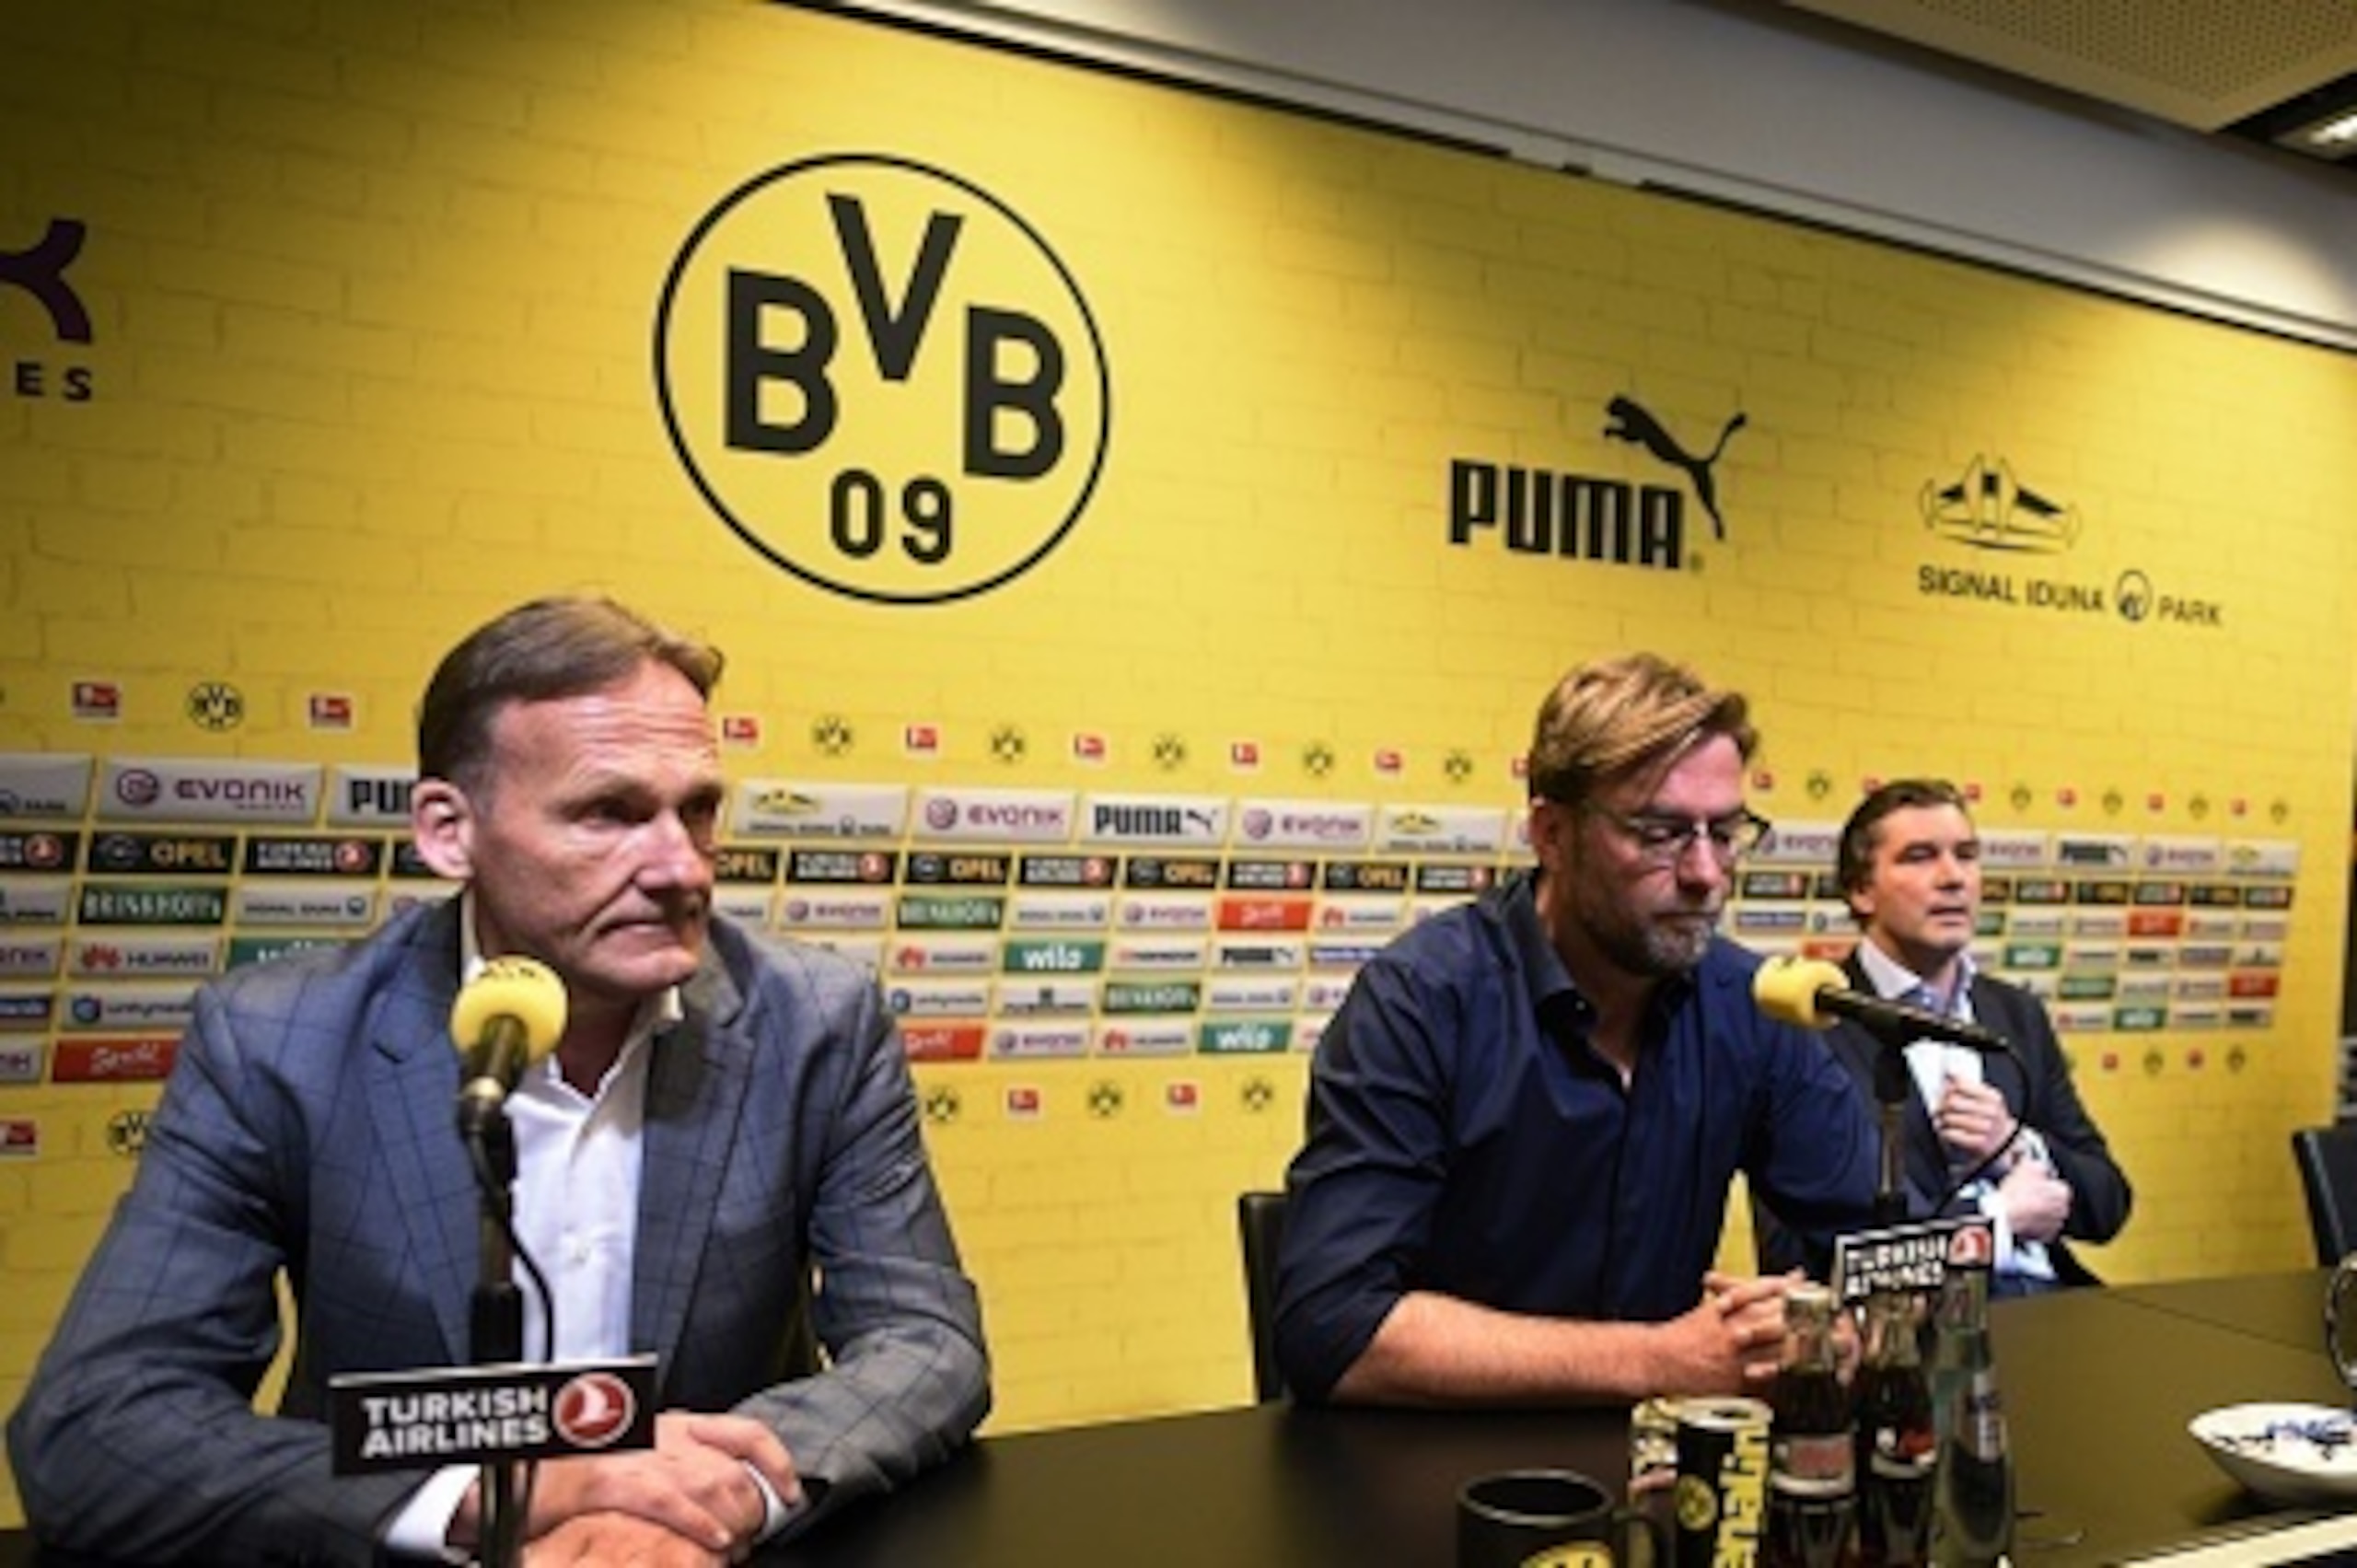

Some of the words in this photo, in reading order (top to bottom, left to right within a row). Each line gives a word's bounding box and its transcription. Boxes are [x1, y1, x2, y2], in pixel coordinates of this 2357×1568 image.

[724, 192, 1066, 482] BVB
[830, 468, 953, 565] 09
[1450, 459, 1683, 570] PUMA
[1918, 564, 2017, 605] SIGNAL
[2026, 580, 2105, 610] IDUNA
[2158, 596, 2222, 627] PARK
[176, 777, 306, 801] EVONIK
[1094, 805, 1182, 835] PUMA
[360, 1386, 548, 1428] TURKISH
[360, 1415, 550, 1459] AIRLINES
